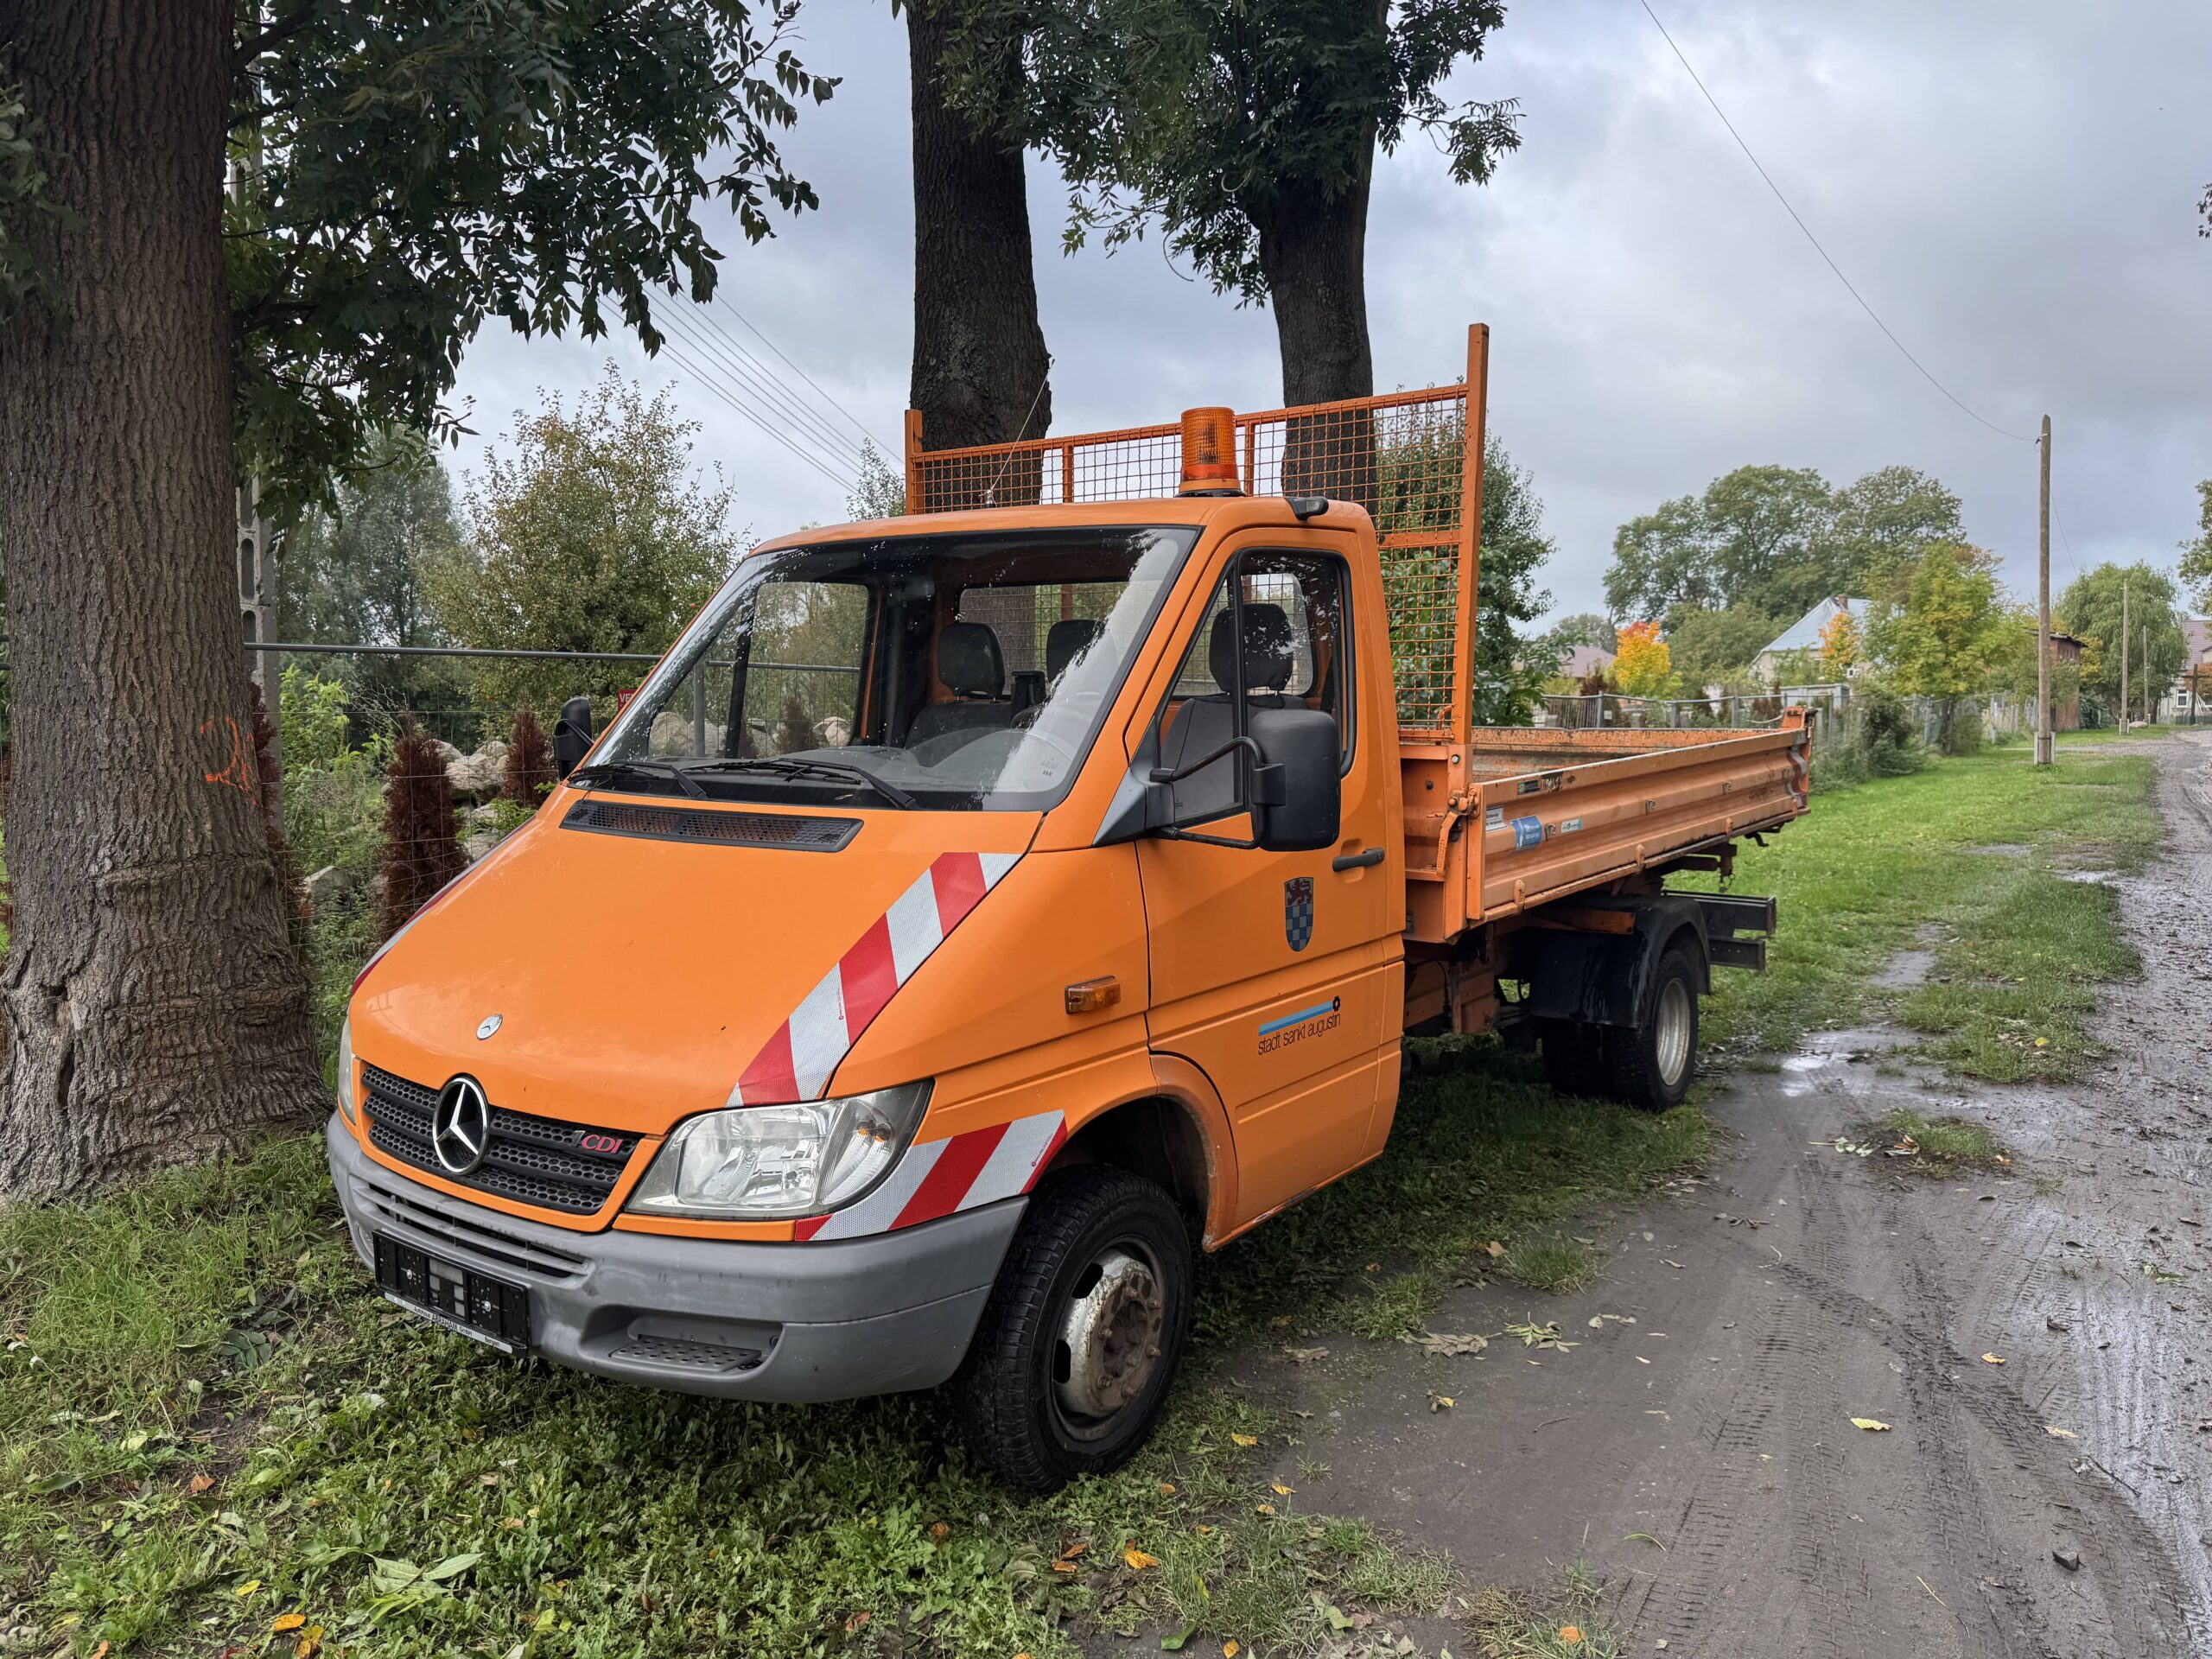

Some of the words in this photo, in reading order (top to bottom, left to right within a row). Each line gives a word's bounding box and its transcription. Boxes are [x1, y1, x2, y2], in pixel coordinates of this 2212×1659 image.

[619, 693, 635, 703] VE
[1258, 1032, 1281, 1055] stadt
[1283, 1023, 1306, 1046] sankt
[1307, 1013, 1341, 1038] augustin
[432, 1313, 458, 1332] ABRAHAM
[459, 1325, 473, 1337] GmbH
[484, 1336, 500, 1347] Bergen
